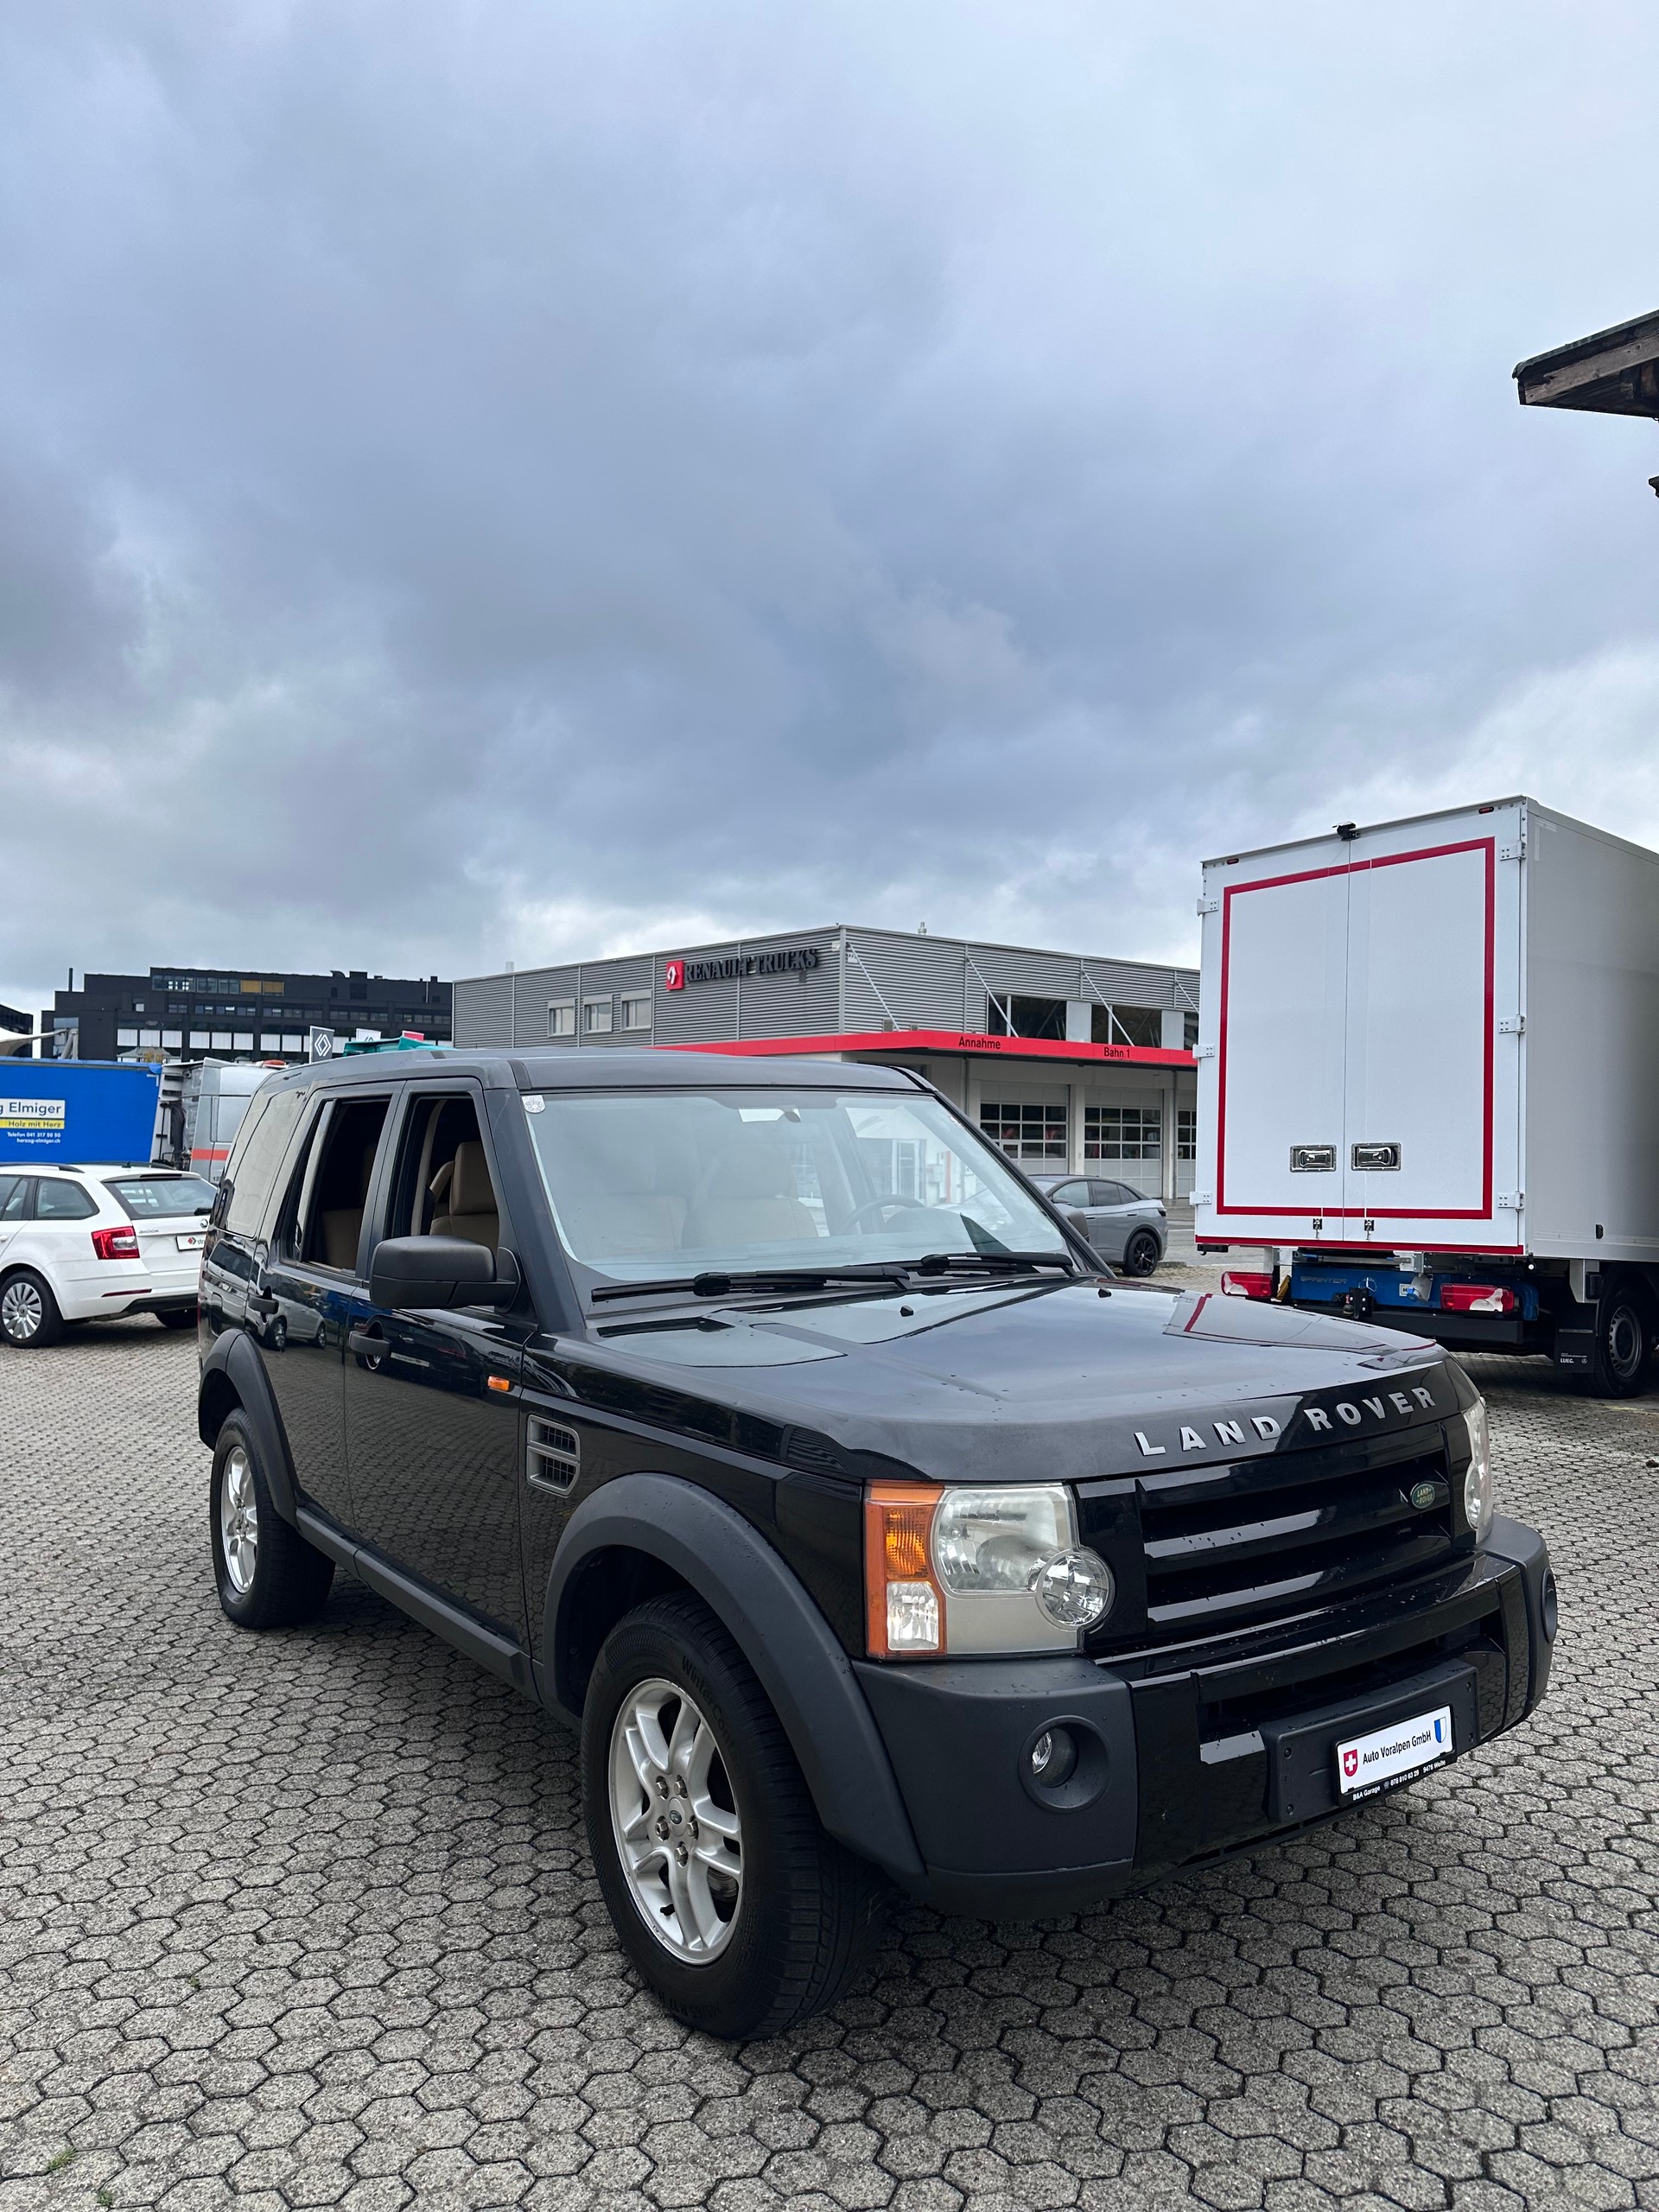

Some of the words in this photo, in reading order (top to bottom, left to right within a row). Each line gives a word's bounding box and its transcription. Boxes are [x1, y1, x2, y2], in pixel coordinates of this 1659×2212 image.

[684, 957, 751, 982] RENAULT
[755, 949, 817, 975] TRUCKS
[958, 1036, 1001, 1049] Annahme
[1104, 1046, 1123, 1058] Bahn
[1126, 1049, 1130, 1058] 1
[9, 1102, 61, 1116] Elmiger
[1300, 1275, 1347, 1284] SPRINTER
[1134, 1416, 1281, 1457] LAND
[1303, 1387, 1436, 1431] ROVER
[1363, 1750, 1379, 1764] Auto
[1380, 1738, 1410, 1758] Voralpen
[1411, 1730, 1432, 1747] GmbH
[1352, 1791, 1363, 1801] B&A
[1363, 1785, 1381, 1796] Garage
